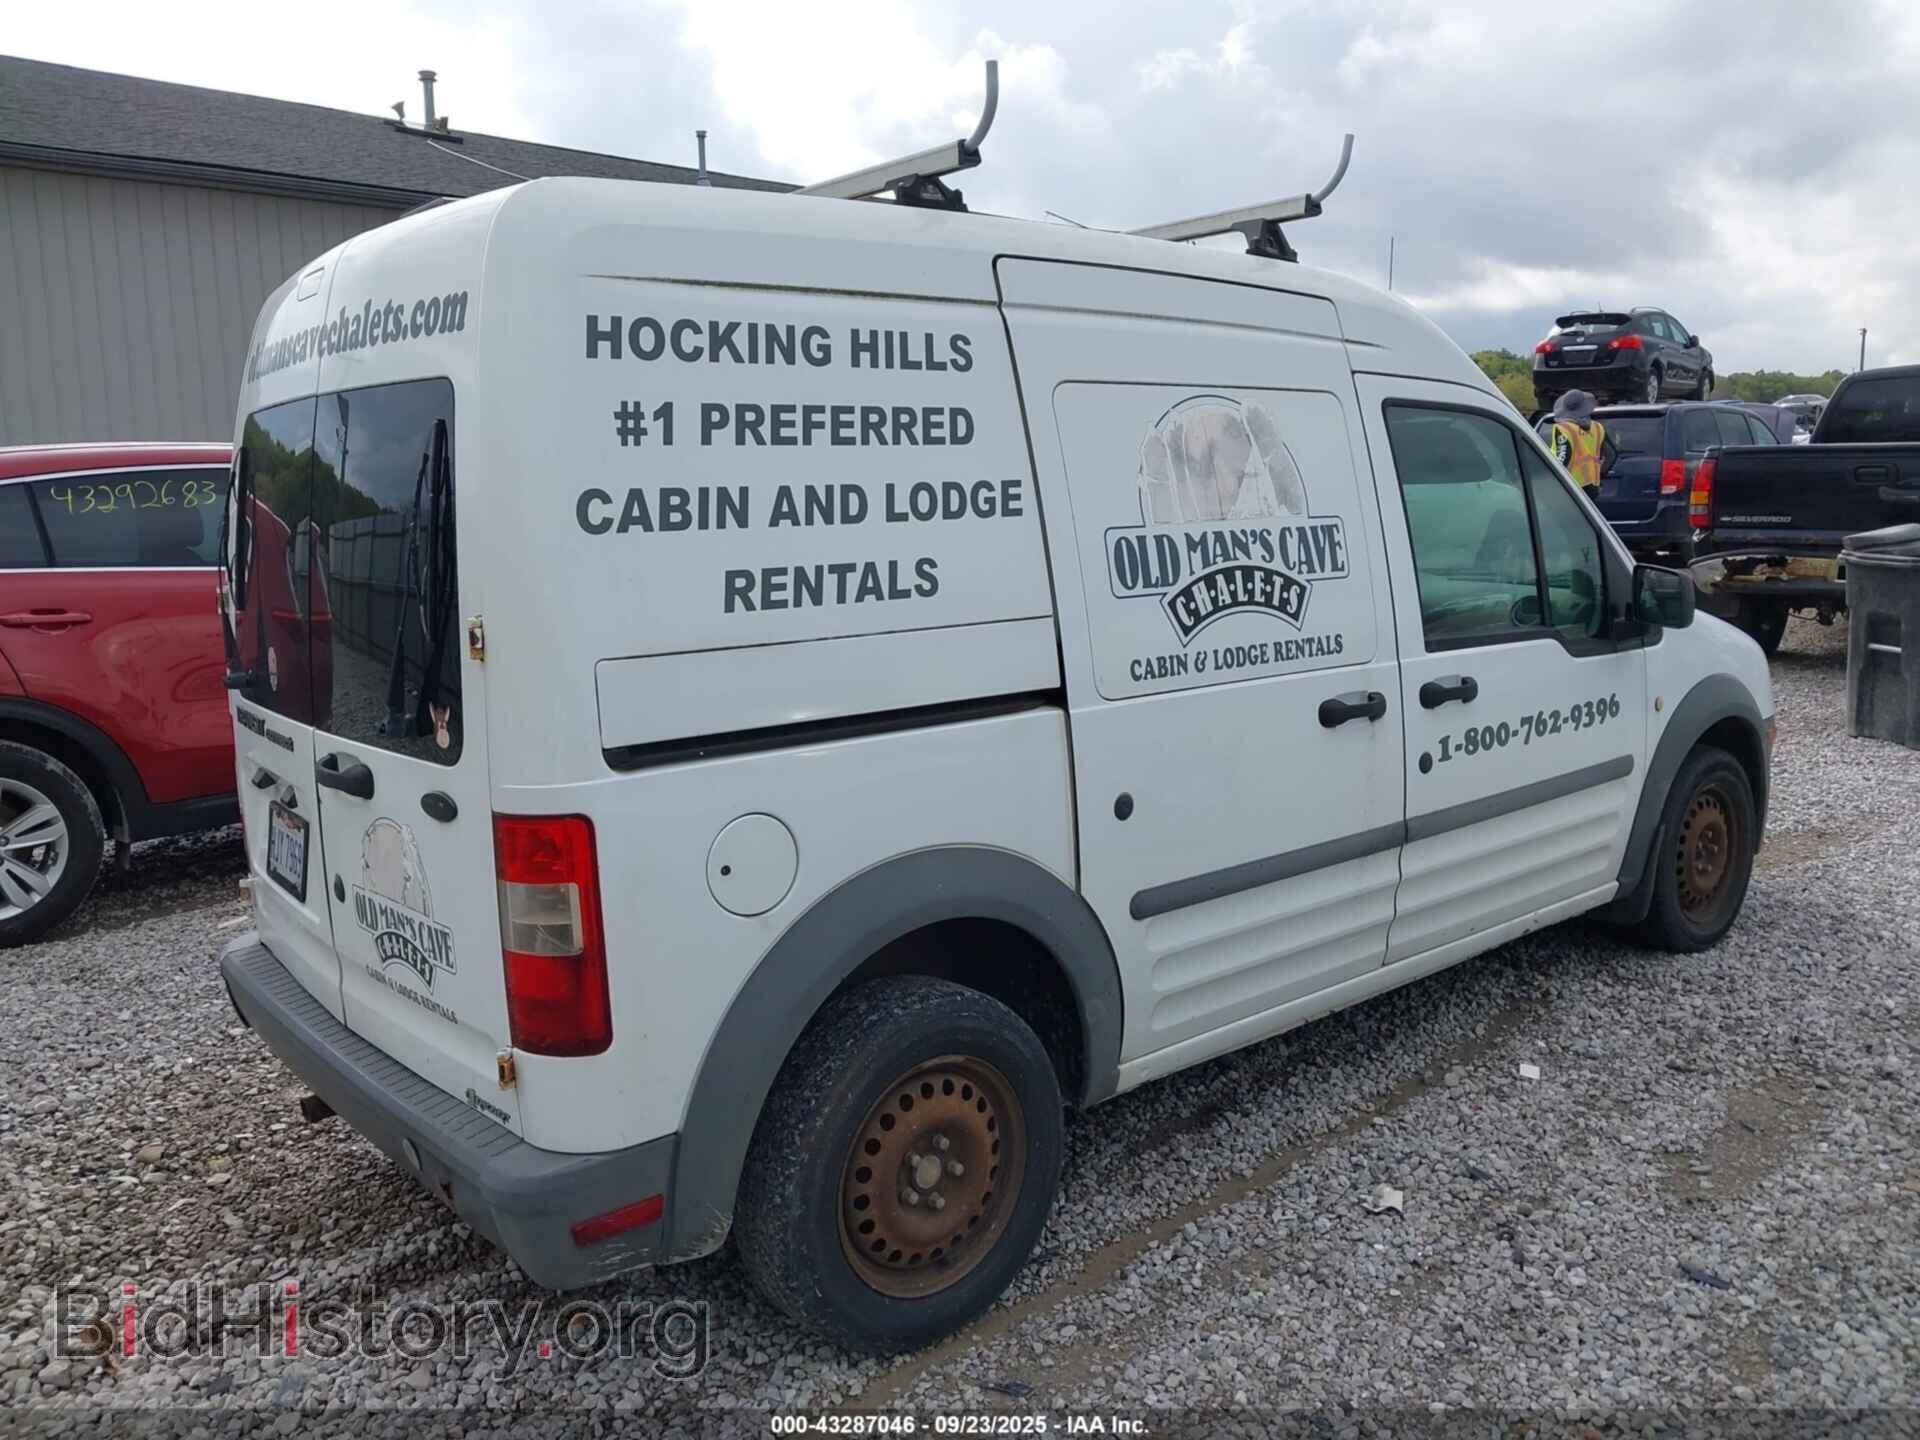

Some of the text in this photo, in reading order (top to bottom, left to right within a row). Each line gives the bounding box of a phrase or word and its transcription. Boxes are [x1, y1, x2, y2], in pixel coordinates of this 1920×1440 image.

[585, 314, 973, 372] HOCKING HILLS
[613, 401, 974, 447] #1 PREFERRED
[51, 480, 217, 514] 43292683
[575, 479, 1023, 535] CABIN AND LODGE
[1732, 515, 1792, 523] SILVERADO
[724, 557, 939, 613] RENTALS
[1113, 523, 1346, 591] OLD MAN'S CAVE
[1130, 633, 1344, 682] CABIN & LODGE RENTALS
[1438, 693, 1620, 763] 1-800-762-9396
[355, 891, 454, 970] OLD MAN'S CAVE
